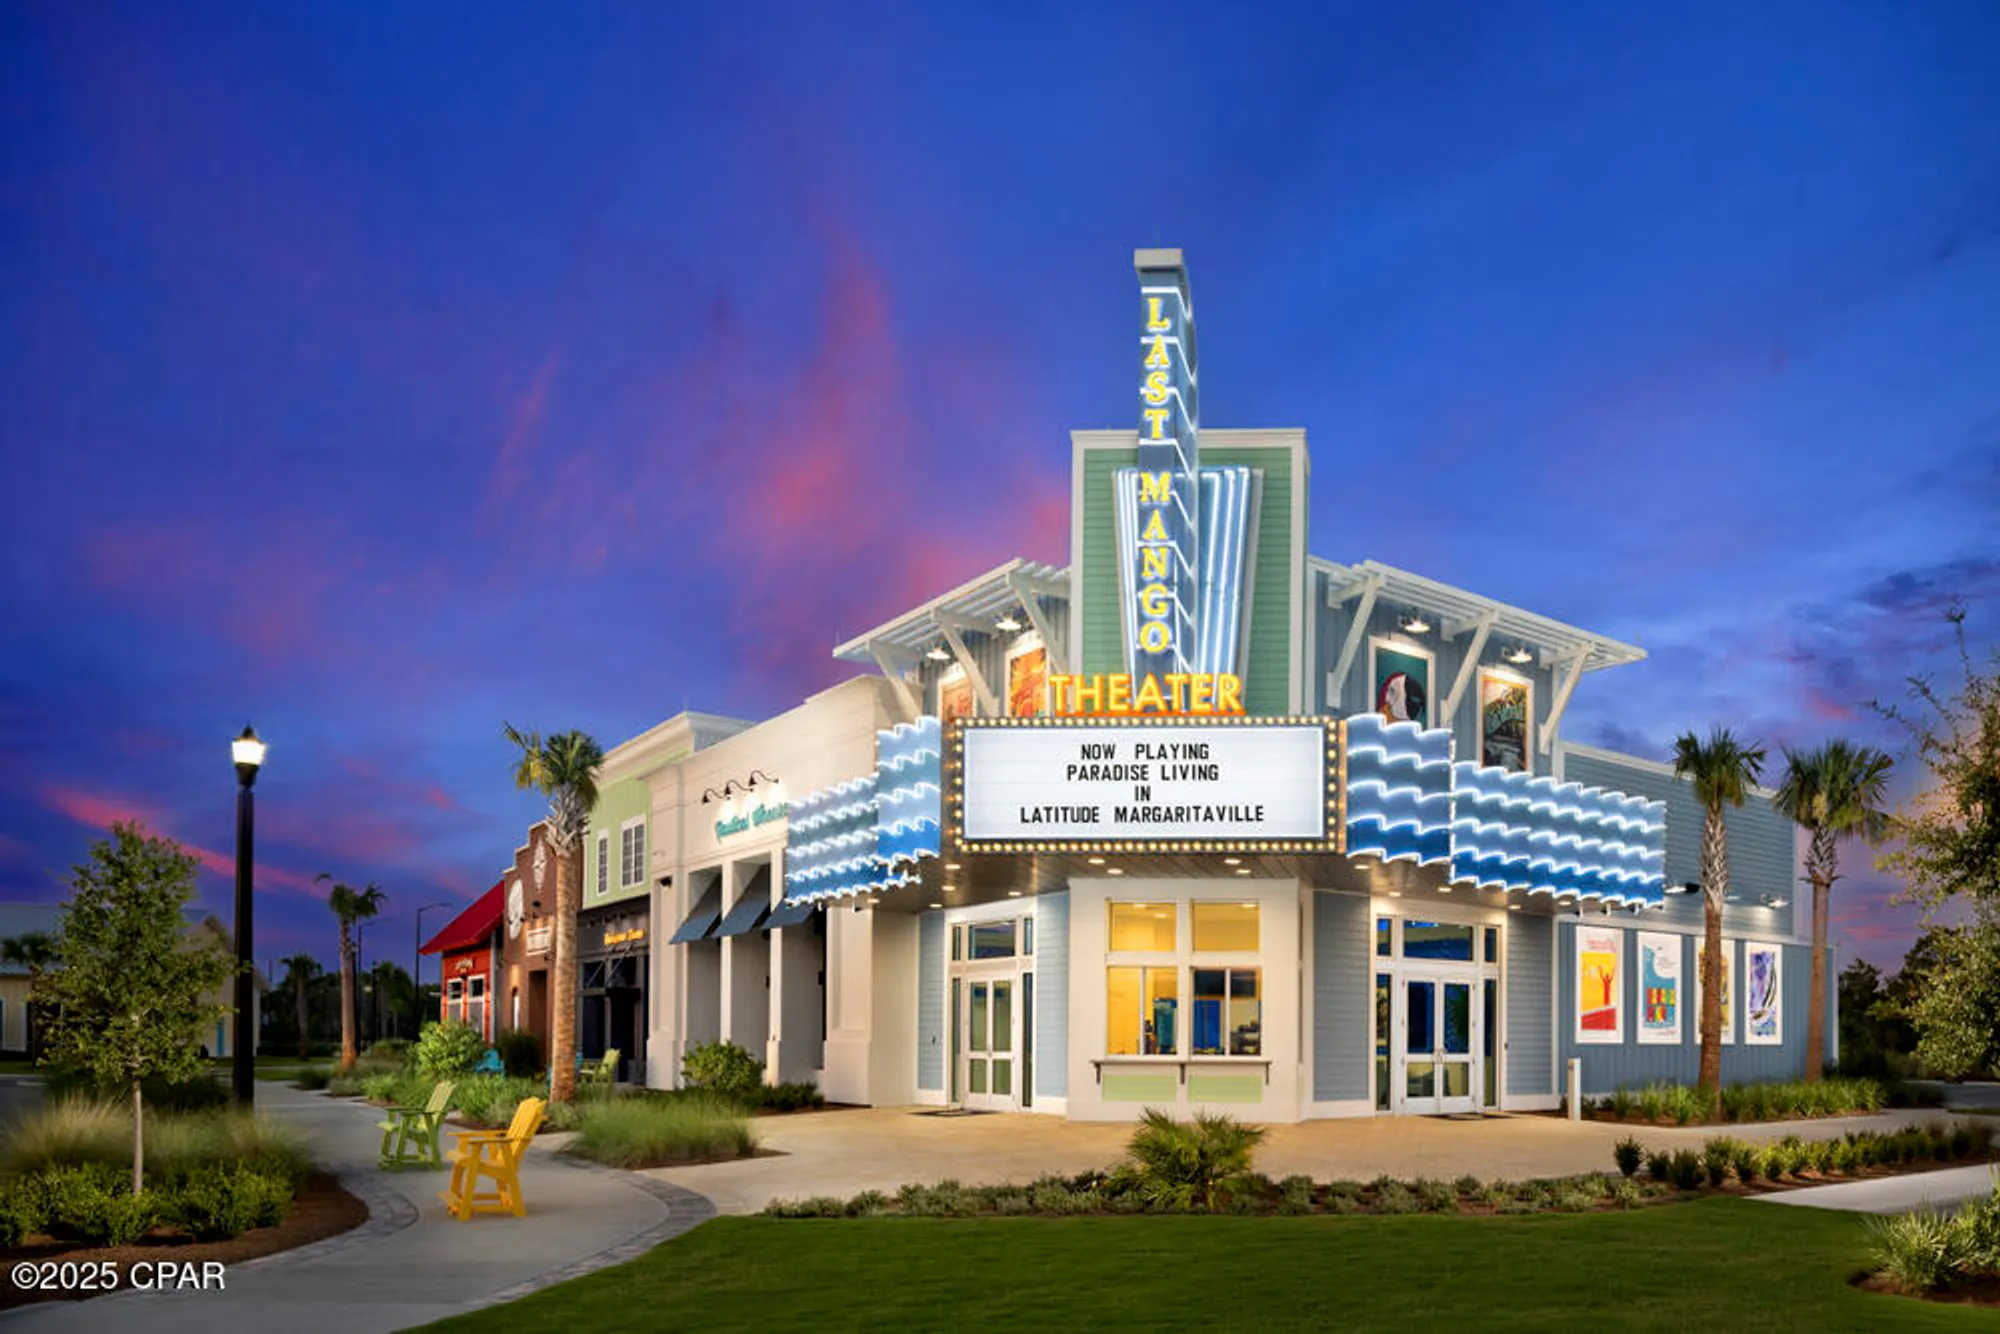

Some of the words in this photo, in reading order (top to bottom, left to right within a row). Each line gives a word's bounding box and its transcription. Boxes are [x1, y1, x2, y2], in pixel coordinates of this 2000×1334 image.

[1145, 297, 1170, 440] LAST
[1140, 472, 1172, 654] MANGO
[1048, 673, 1246, 715] THEATER
[1081, 743, 1116, 760] NOW
[1135, 743, 1209, 760] PLAYING
[1067, 764, 1149, 781] PARADISE
[1161, 764, 1219, 781] LIVING
[1135, 785, 1151, 802] IN
[1020, 806, 1100, 824] LATITUDE
[1114, 805, 1264, 823] MARGARITAVILLE
